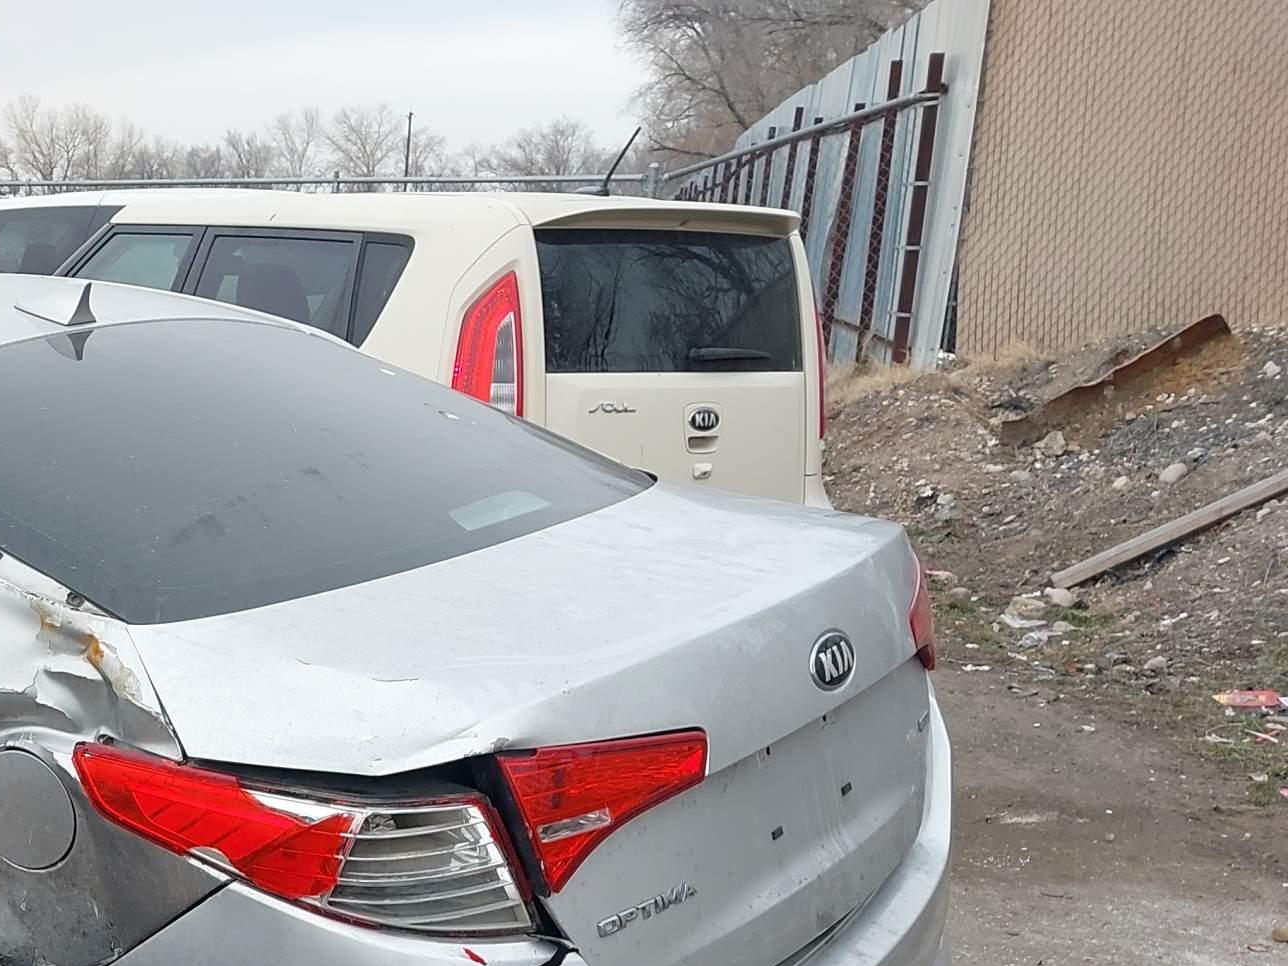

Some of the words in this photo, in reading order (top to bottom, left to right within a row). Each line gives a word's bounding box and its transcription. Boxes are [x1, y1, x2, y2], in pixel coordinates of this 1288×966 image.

[695, 411, 717, 428] KIA
[818, 640, 853, 682] KIA
[597, 881, 697, 938] OPTIMA
